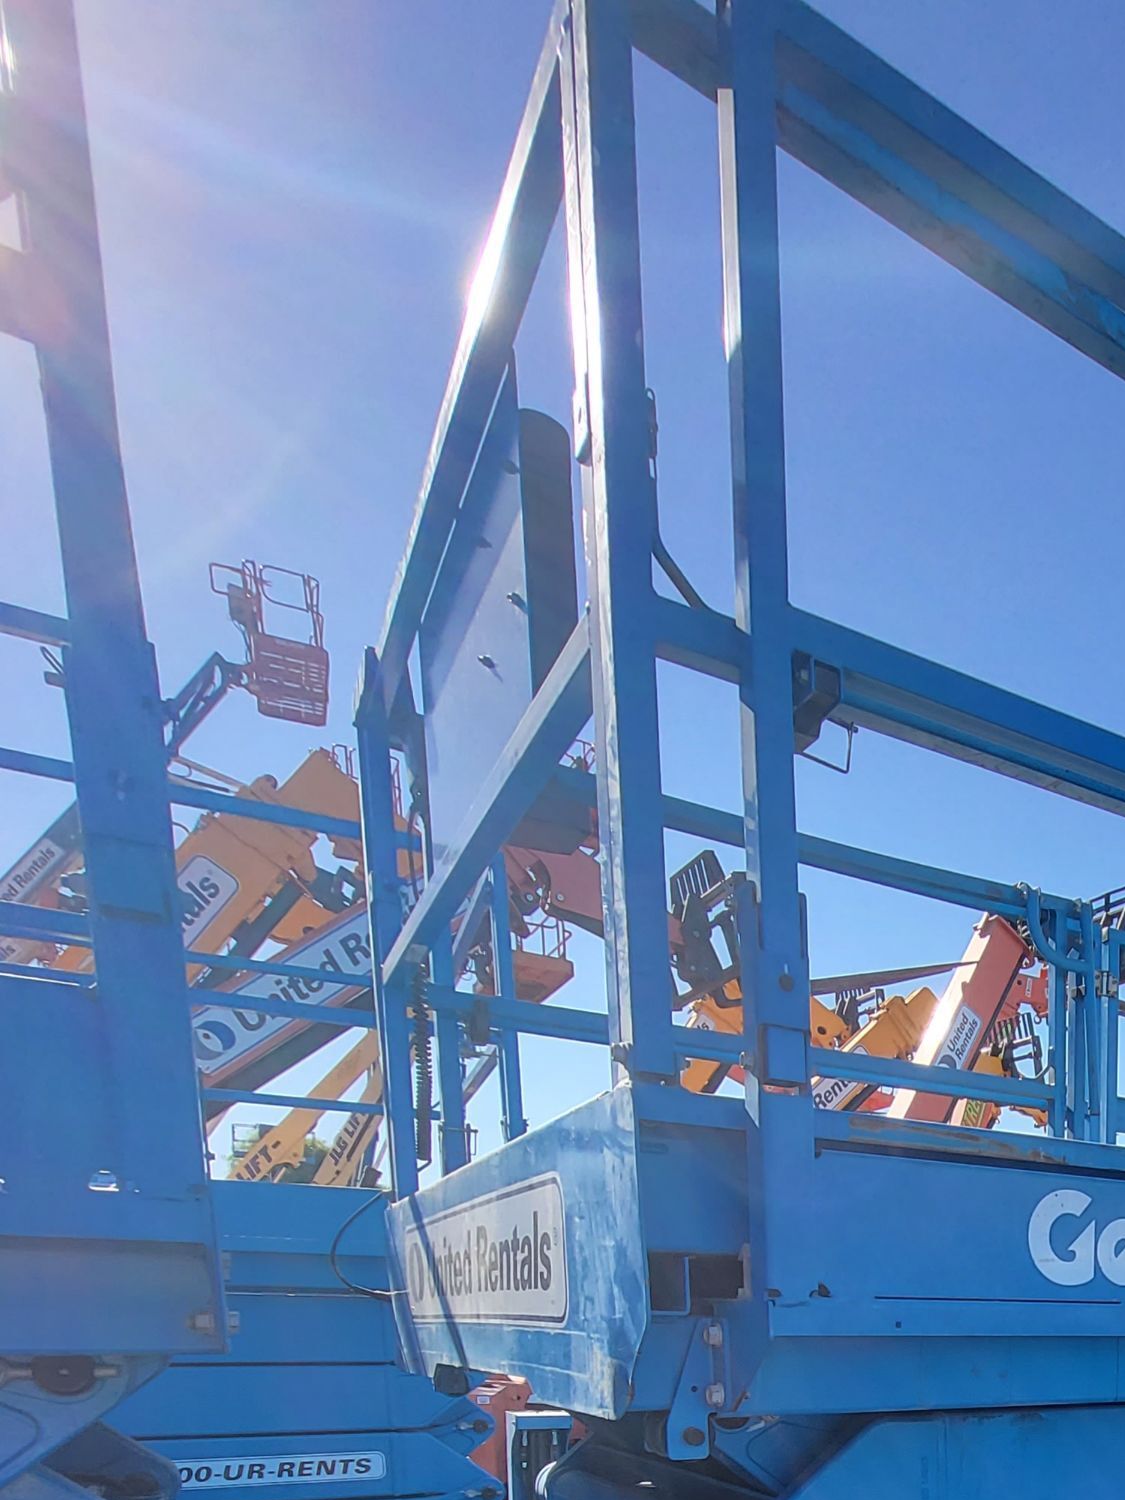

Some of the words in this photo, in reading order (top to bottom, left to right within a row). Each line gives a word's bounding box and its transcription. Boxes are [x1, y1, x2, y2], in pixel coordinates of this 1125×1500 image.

[13, 847, 56, 889] Rentals
[947, 1012, 969, 1052] United
[955, 1017, 979, 1061] Rentals
[814, 1079, 851, 1108] Rent
[328, 1136, 348, 1167] JLG
[427, 1230, 473, 1298] United
[476, 1210, 552, 1292] Rentals
[178, 1458, 372, 1484] 00-UR-RENTS
